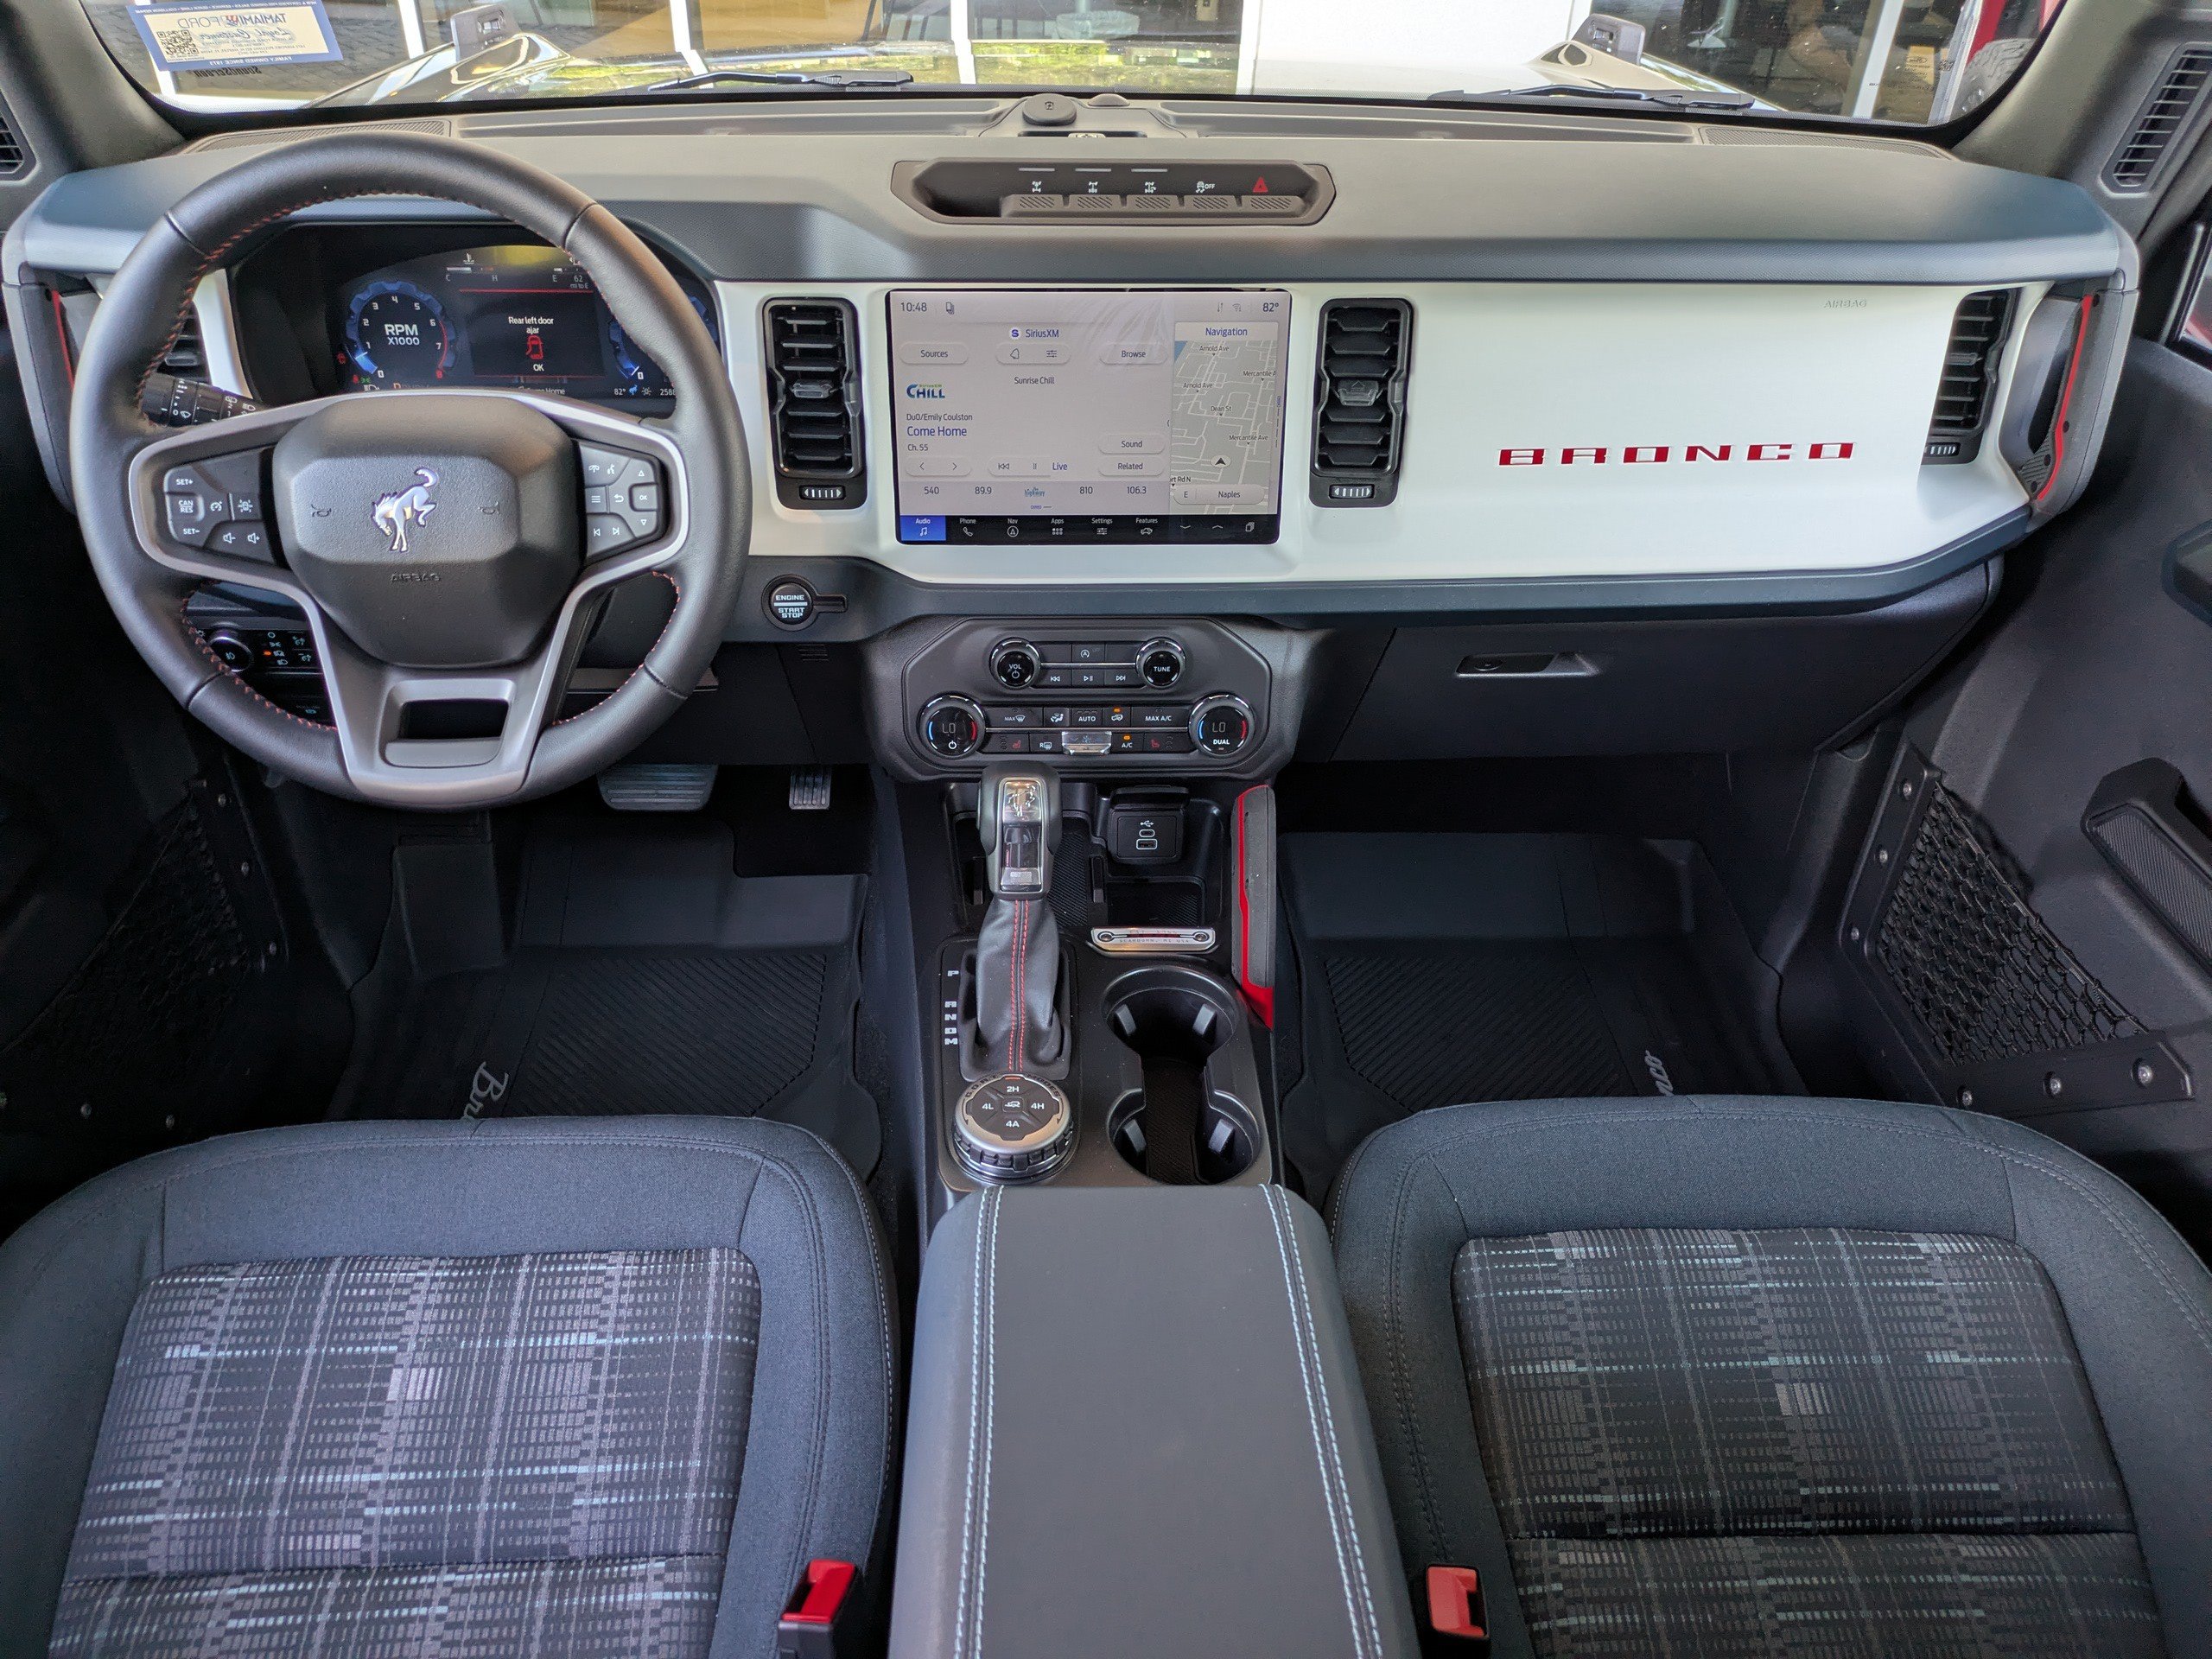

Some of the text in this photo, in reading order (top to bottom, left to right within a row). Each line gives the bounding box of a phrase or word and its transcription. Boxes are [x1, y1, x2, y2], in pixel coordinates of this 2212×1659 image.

[900, 302, 927, 313] 10:48
[1262, 302, 1280, 313] 82°
[1823, 299, 1867, 308] AIRBAG
[508, 316, 554, 325] Rear left door
[385, 324, 419, 335] RPM
[526, 326, 539, 335] ajar
[1025, 328, 1060, 338] SiriusXM
[1205, 327, 1248, 338] Navigation
[387, 337, 420, 346] X1000
[920, 349, 949, 359] Sources
[1121, 350, 1147, 359] Browse
[533, 364, 544, 372] OK
[378, 370, 385, 378] 0
[637, 372, 644, 380] 0
[1014, 376, 1055, 385] Sunrise Chill
[906, 384, 946, 398] CHILL
[943, 413, 973, 422] Coulston
[907, 426, 967, 436] Come Home
[1498, 442, 1855, 467] BRONCO
[1052, 462, 1068, 471] Live
[1117, 462, 1143, 471] Related
[924, 486, 939, 495] 540
[975, 486, 993, 495] 89.9
[1079, 486, 1093, 495] 810
[1127, 486, 1147, 495] 106.3
[1218, 491, 1241, 499] Naples
